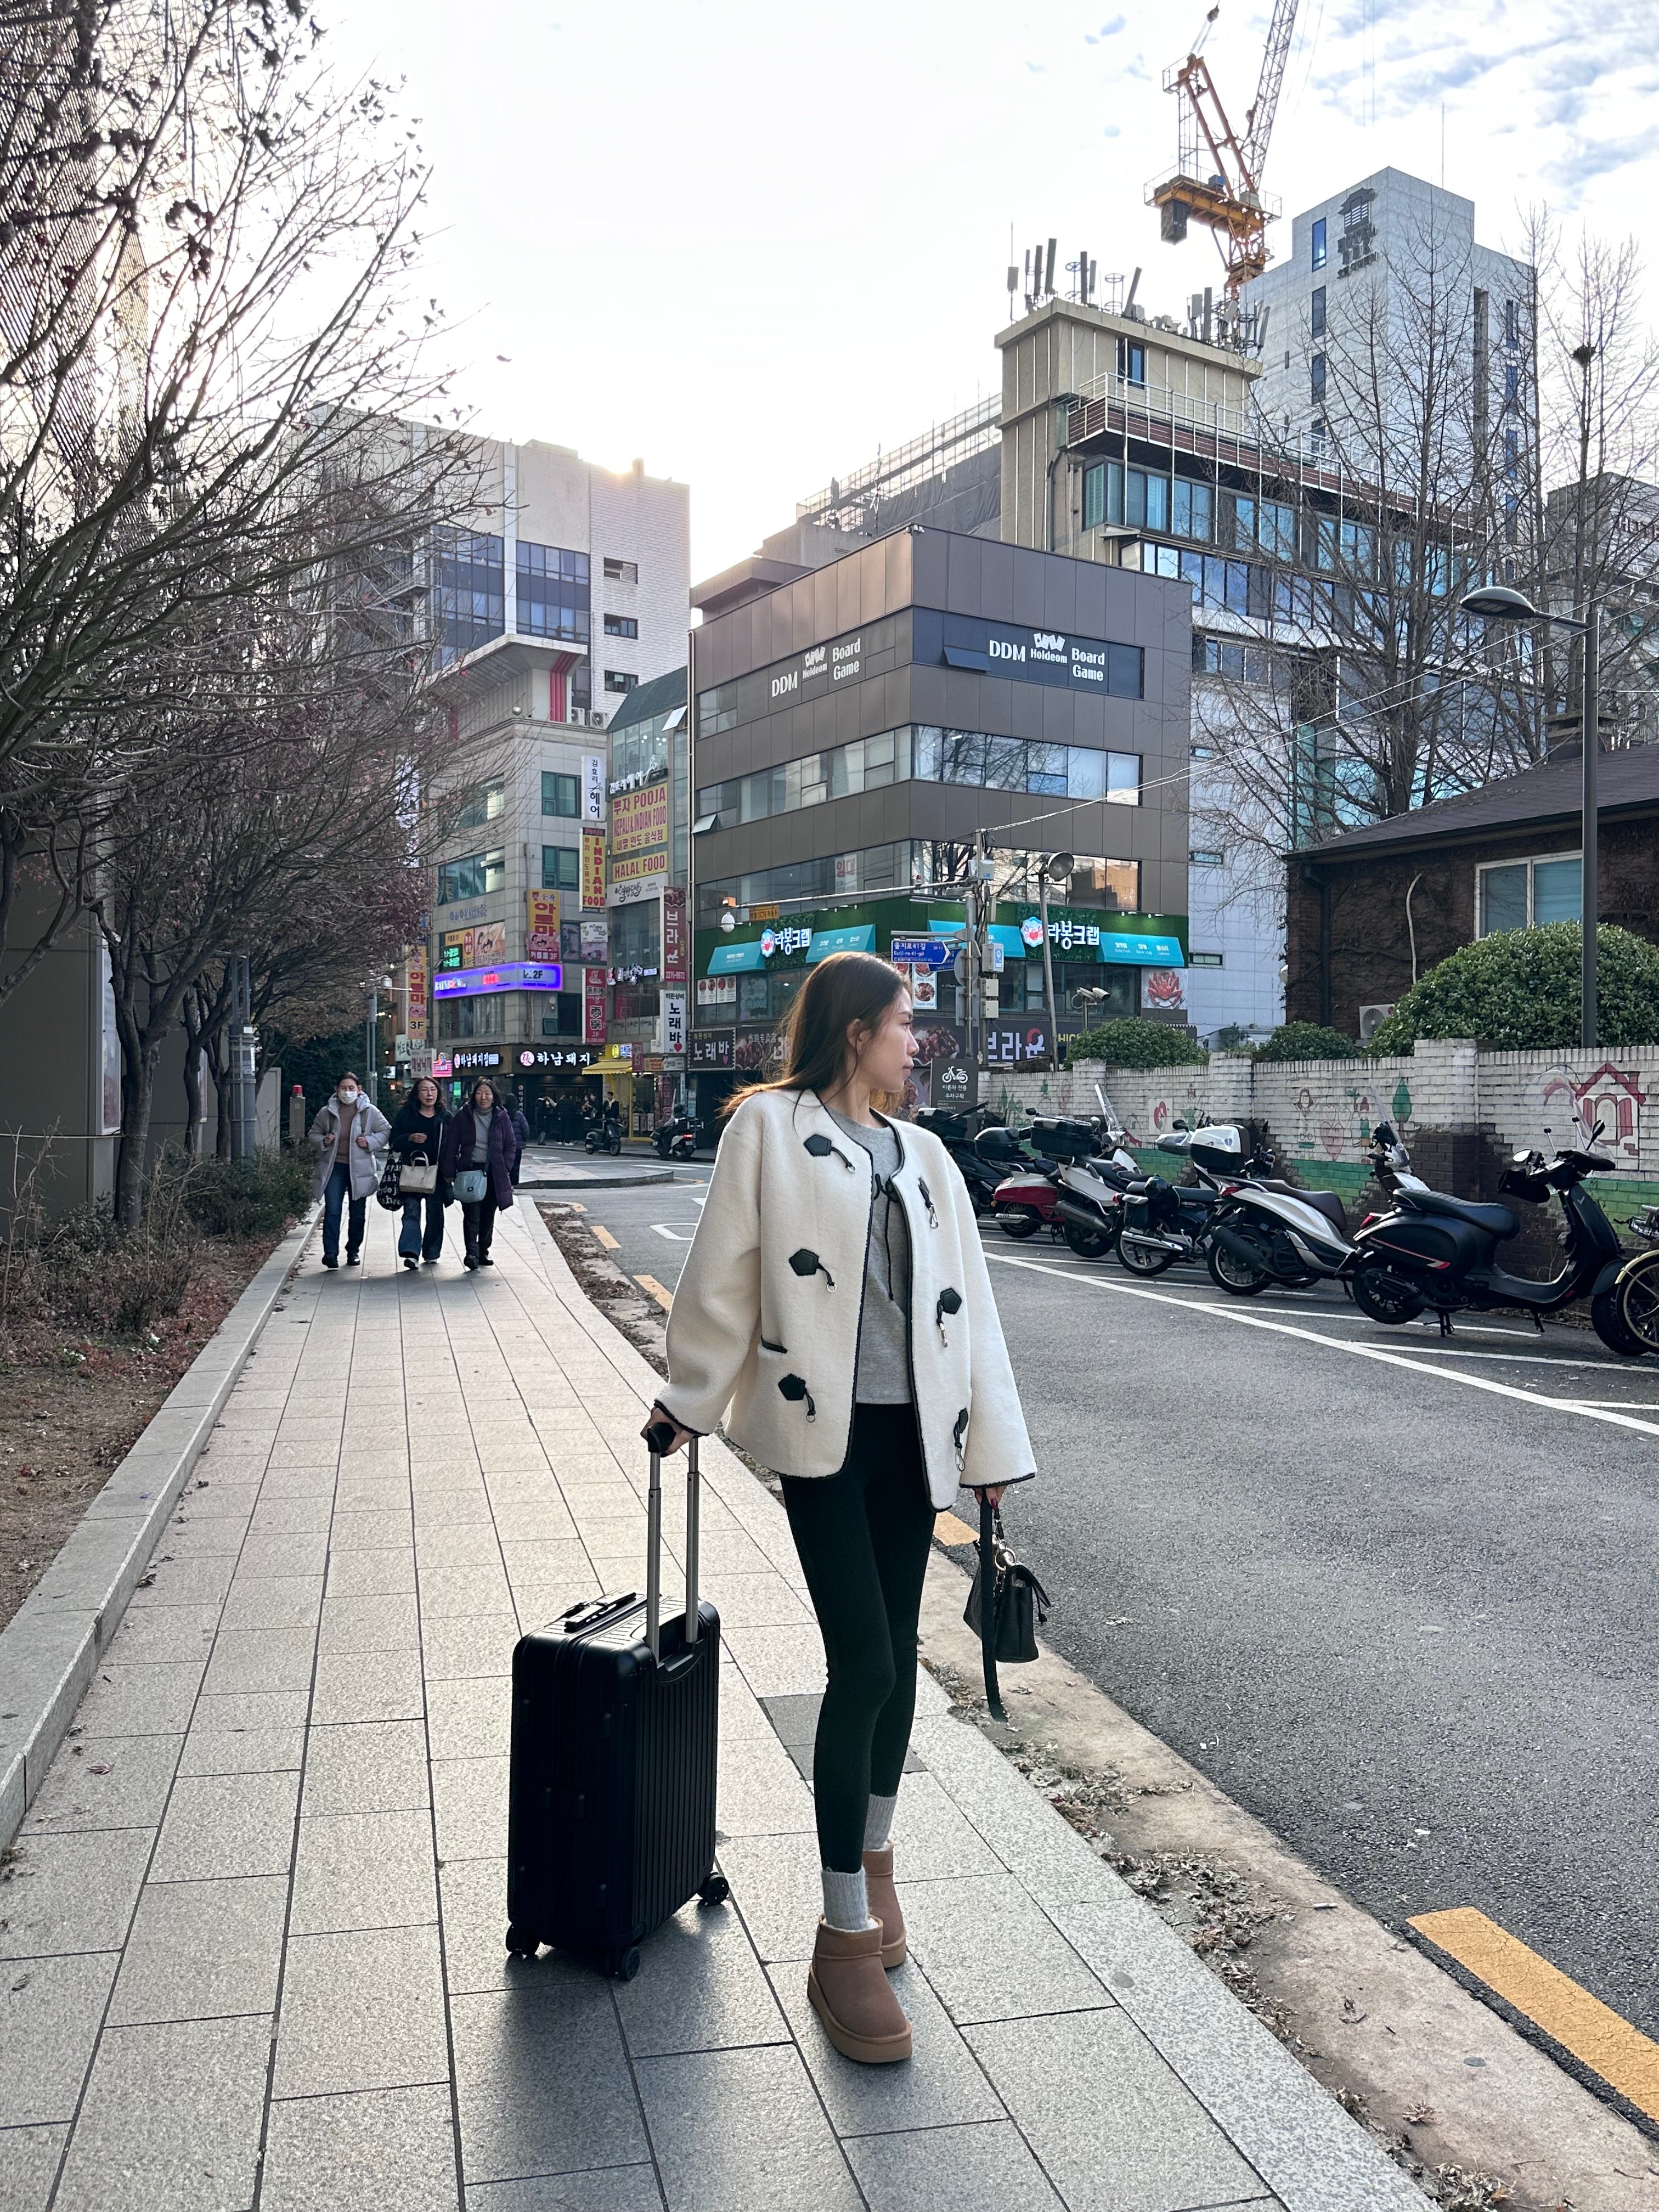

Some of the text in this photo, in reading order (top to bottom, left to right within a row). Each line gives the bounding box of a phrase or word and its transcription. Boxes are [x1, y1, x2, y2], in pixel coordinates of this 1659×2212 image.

[832, 637, 861, 662] Board
[989, 640, 1068, 664] DDM Holdeom
[1071, 648, 1105, 665] Board
[772, 663, 827, 697] DDM Holdeom
[833, 661, 860, 681] Game
[1073, 664, 1104, 681] Game
[590, 792, 600, 819] 헤어
[634, 787, 665, 810] POOJA
[653, 805, 666, 826] FOOD
[631, 834, 642, 848] 인도
[645, 829, 663, 844] 음식점
[592, 837, 602, 895] INDIAN
[615, 855, 665, 879] HALAL FOOD
[583, 896, 605, 906] FOOD
[775, 927, 812, 955] 라봉크랩
[1047, 921, 1099, 950] 라봉크랩
[533, 970, 543, 979] 2F
[410, 1021, 425, 1030] 3F
[537, 1051, 590, 1066] 하남돼지
[693, 1041, 729, 1061] 노래바
